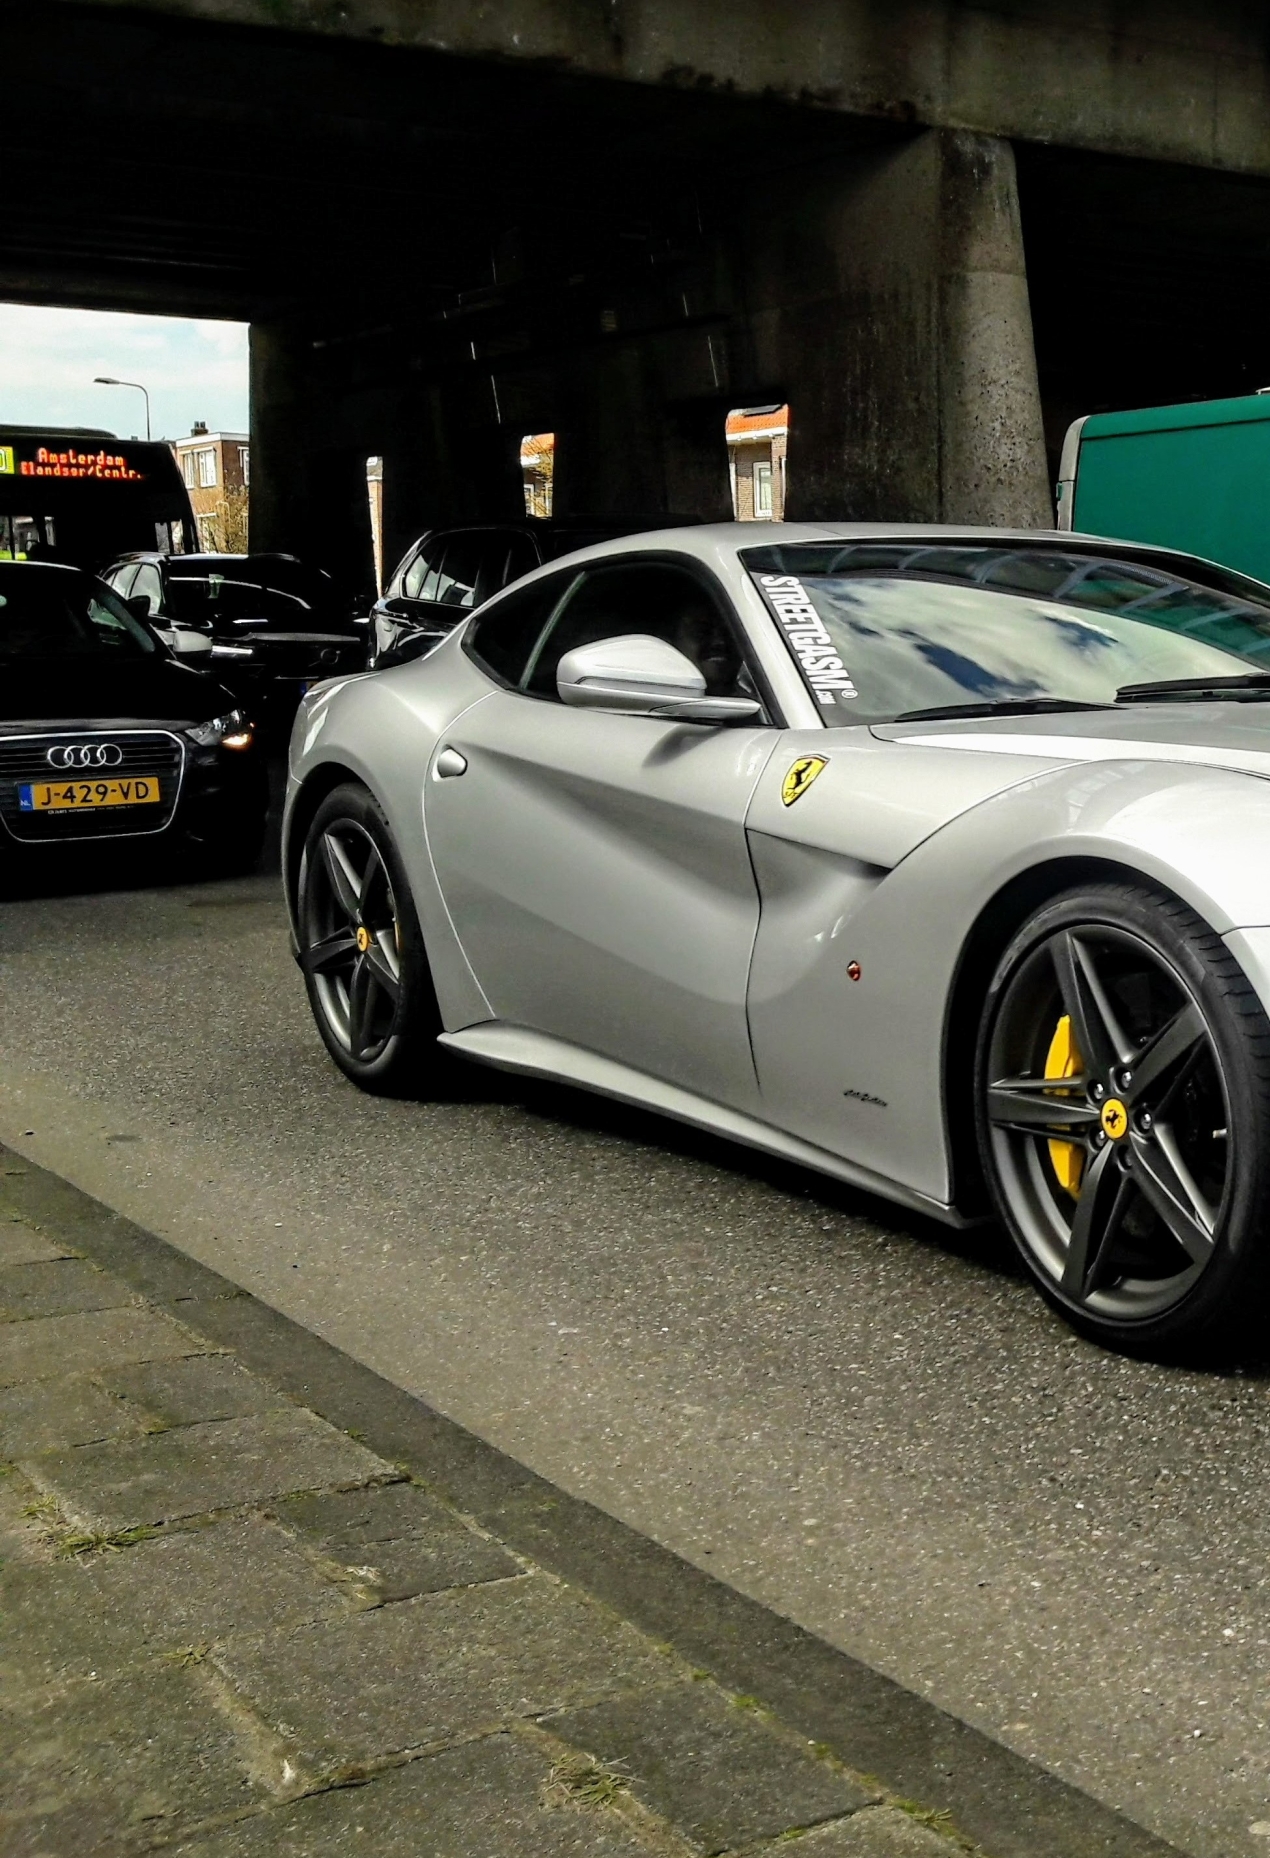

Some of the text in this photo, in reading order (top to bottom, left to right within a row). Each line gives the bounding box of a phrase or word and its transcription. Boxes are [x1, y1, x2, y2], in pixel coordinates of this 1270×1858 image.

[37, 447, 124, 466] Amsterdam
[760, 575, 854, 691] STREETGASM
[41, 781, 149, 806] J-429-VD
